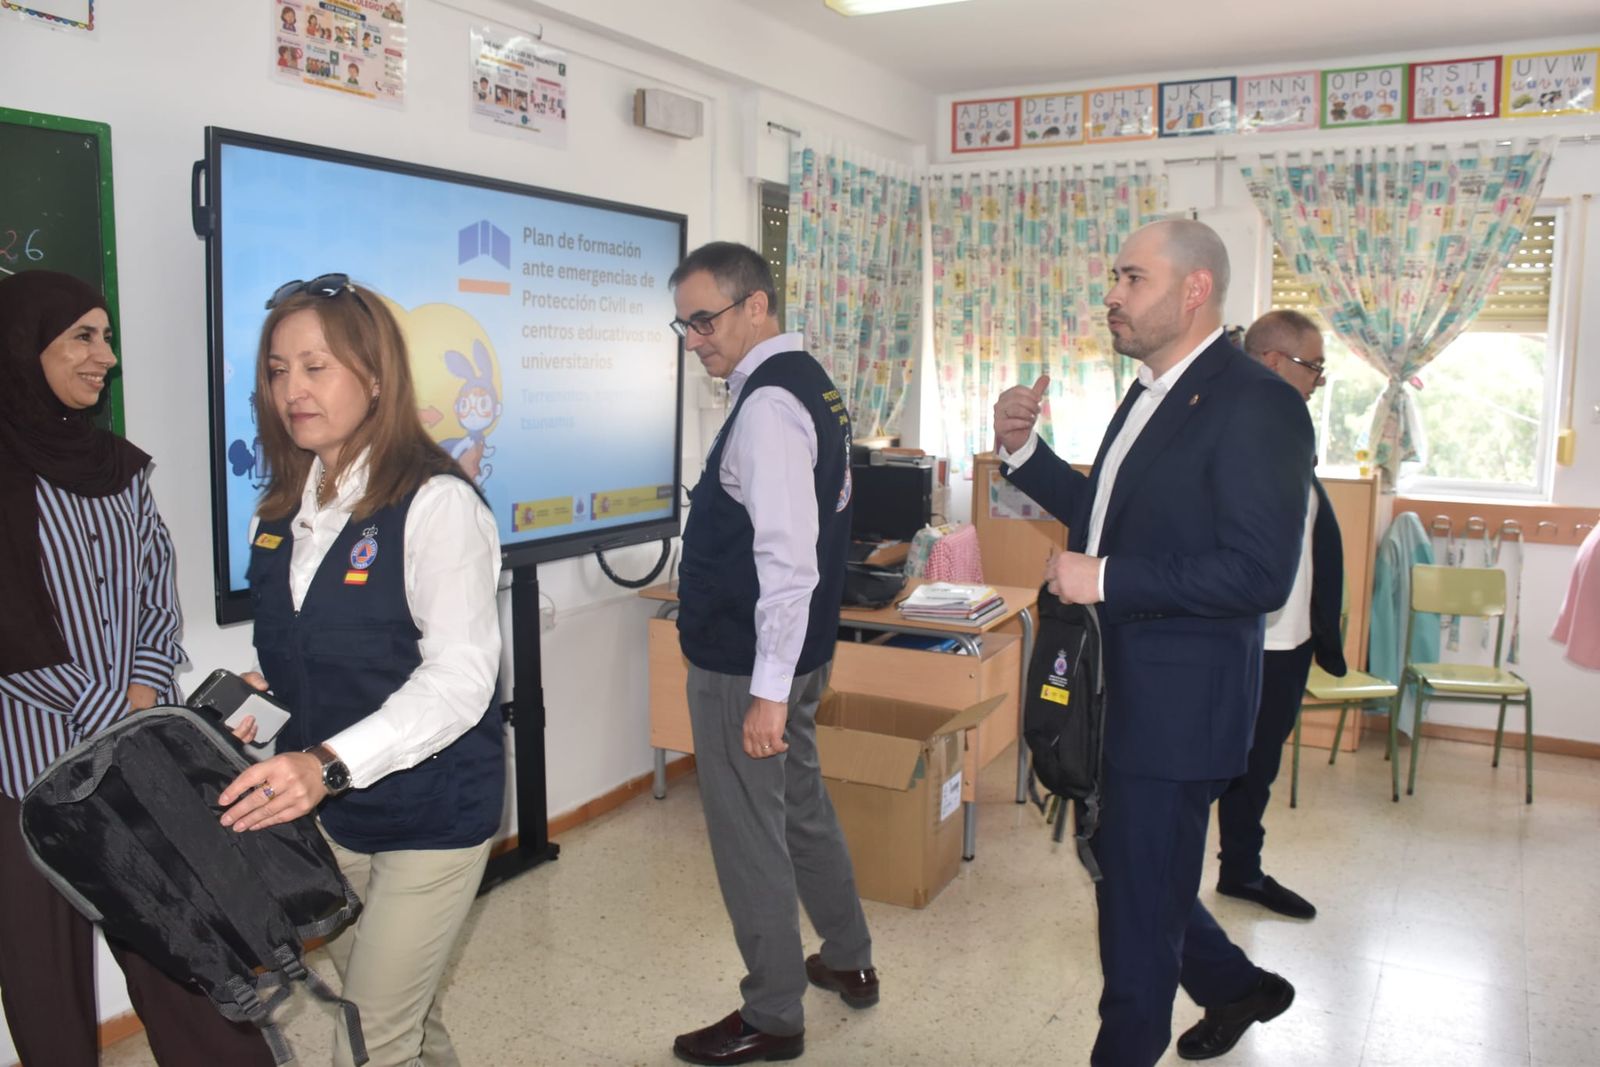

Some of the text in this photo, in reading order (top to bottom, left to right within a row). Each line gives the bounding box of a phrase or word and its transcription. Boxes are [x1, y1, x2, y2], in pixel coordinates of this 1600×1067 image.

[523, 226, 641, 258] Plan de formación
[522, 262, 655, 288] ante emergencias de
[522, 289, 644, 315] Protección Civil en
[522, 324, 663, 343] centros educativos no
[521, 352, 614, 370] universitarios
